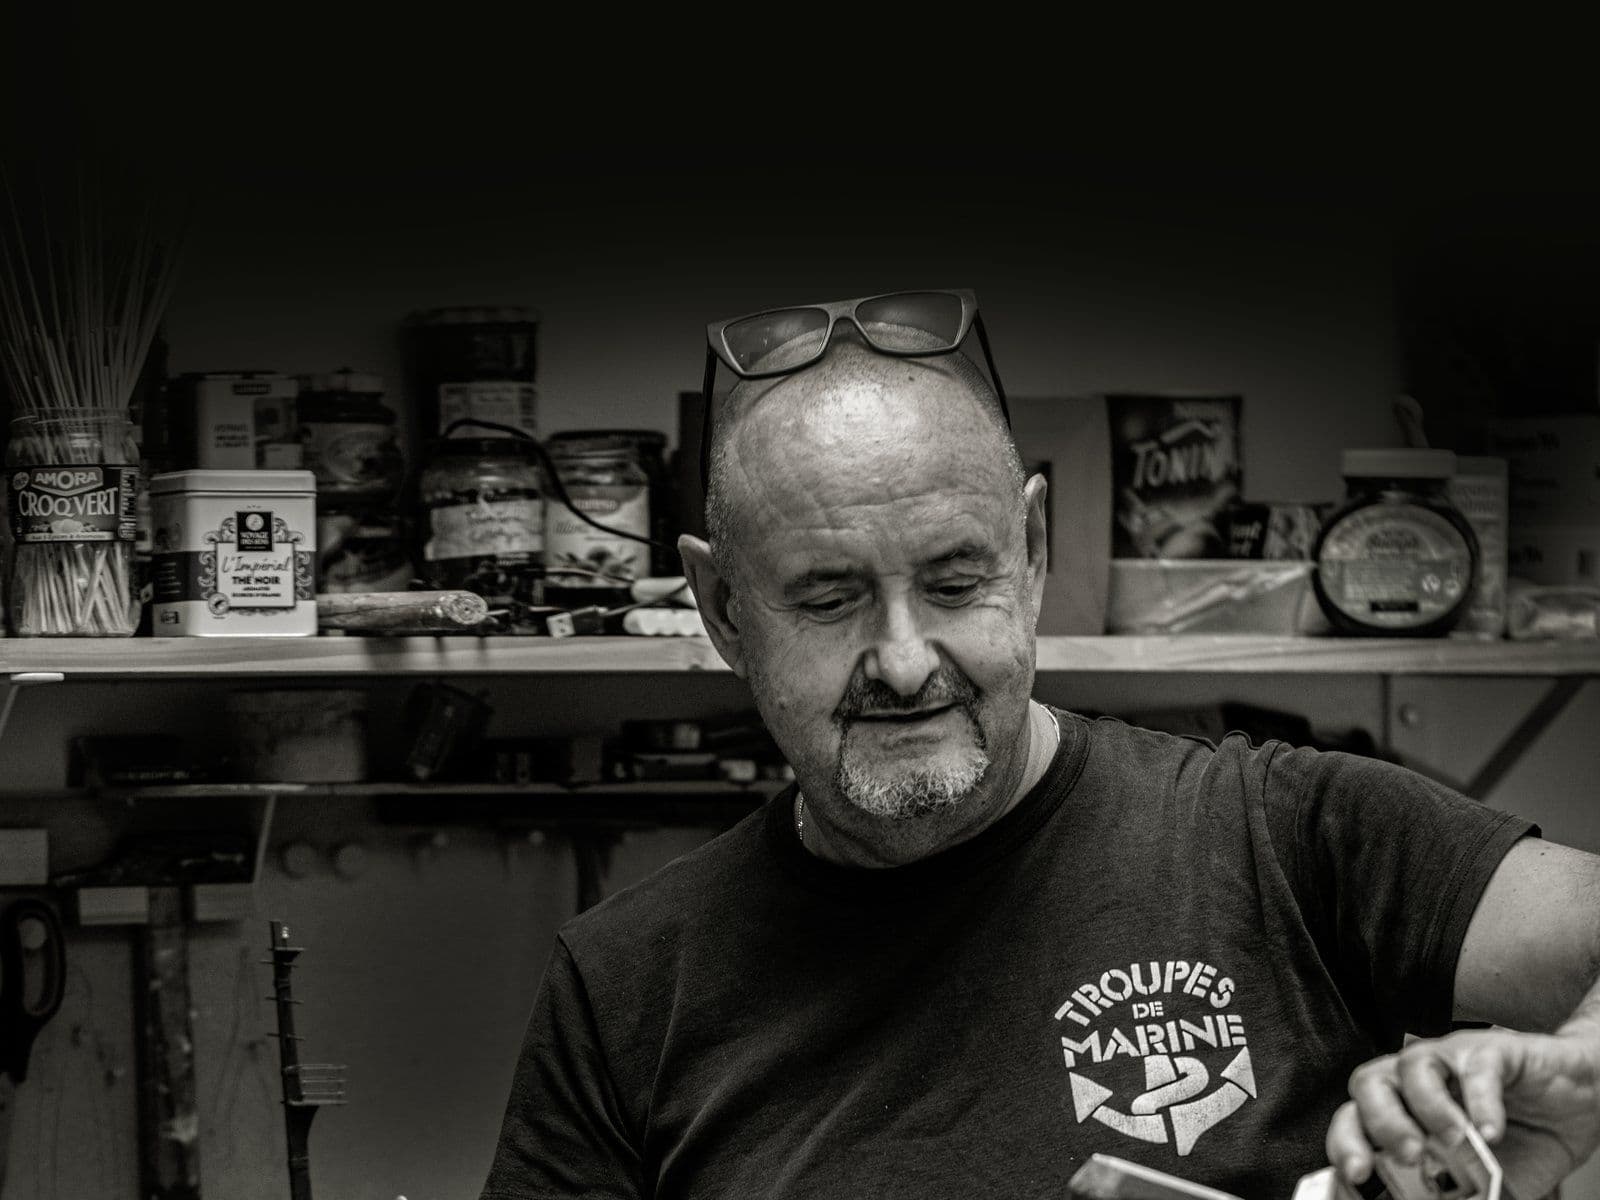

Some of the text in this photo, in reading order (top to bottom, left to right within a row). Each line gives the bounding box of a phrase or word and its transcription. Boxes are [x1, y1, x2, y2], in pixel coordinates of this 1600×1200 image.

[35, 470, 97, 489] AMORA
[254, 576, 281, 585] NOIR
[1054, 960, 1235, 1027] TROUPES
[1132, 1001, 1164, 1019] DE
[1061, 1014, 1247, 1068] MARINE
